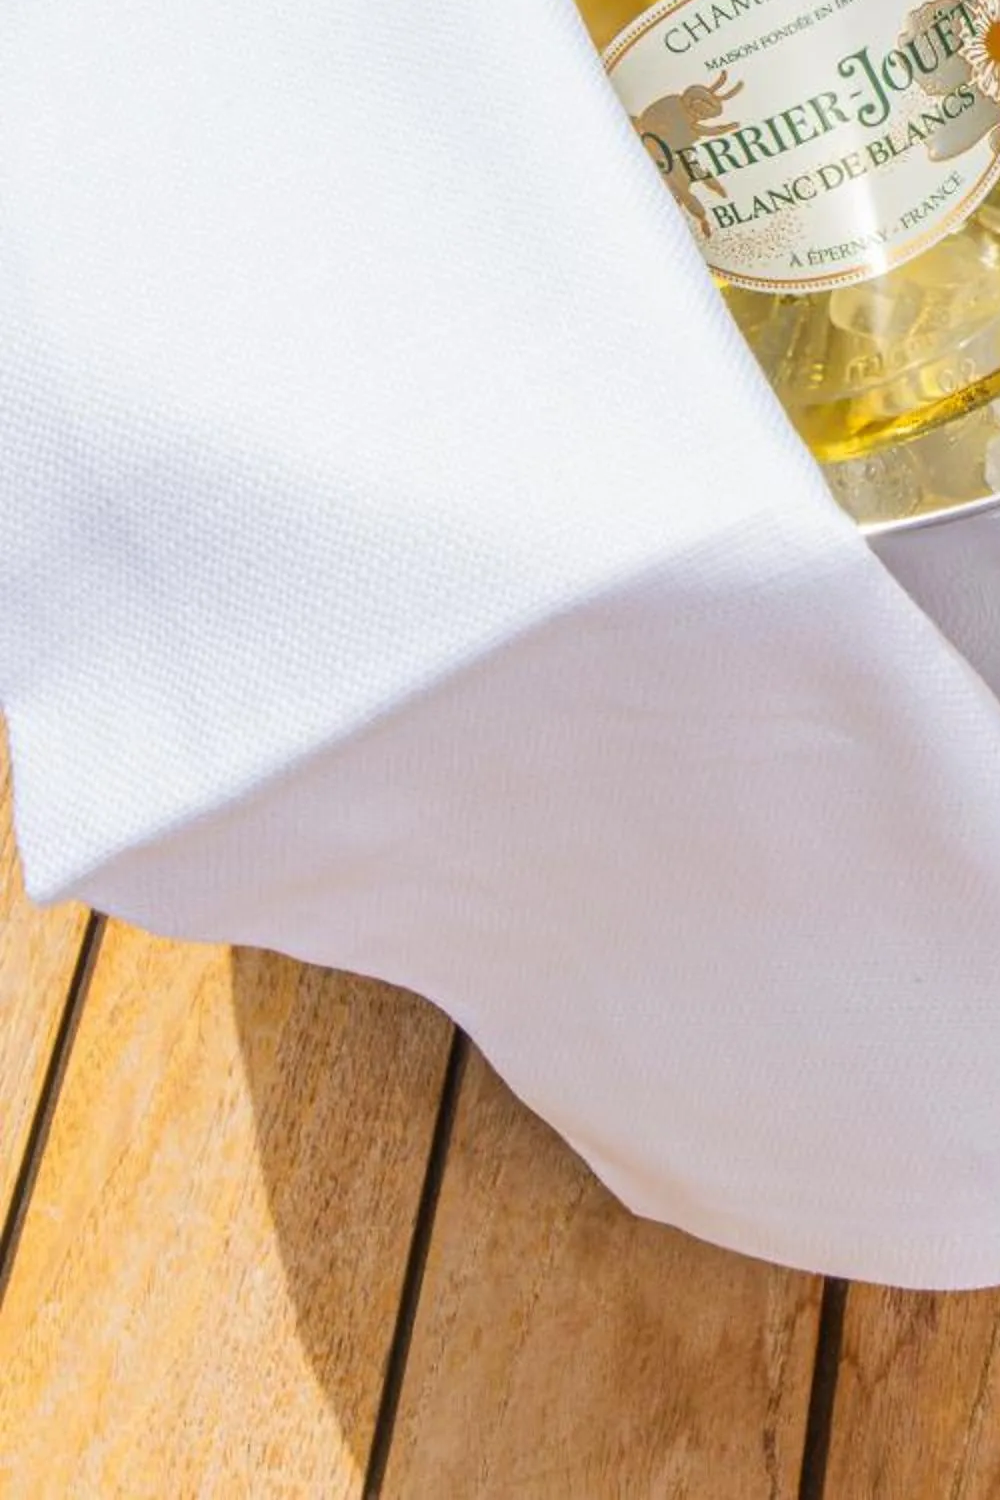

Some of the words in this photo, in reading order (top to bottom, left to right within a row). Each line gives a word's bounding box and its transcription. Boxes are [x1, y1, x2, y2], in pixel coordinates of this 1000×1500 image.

[704, 40, 759, 71] MAISON
[813, 3, 833, 20] EN
[711, 175, 818, 229] BLANC
[816, 152, 869, 191] DE
[865, 83, 976, 167] BLANCS
[899, 170, 966, 229] FRANCE
